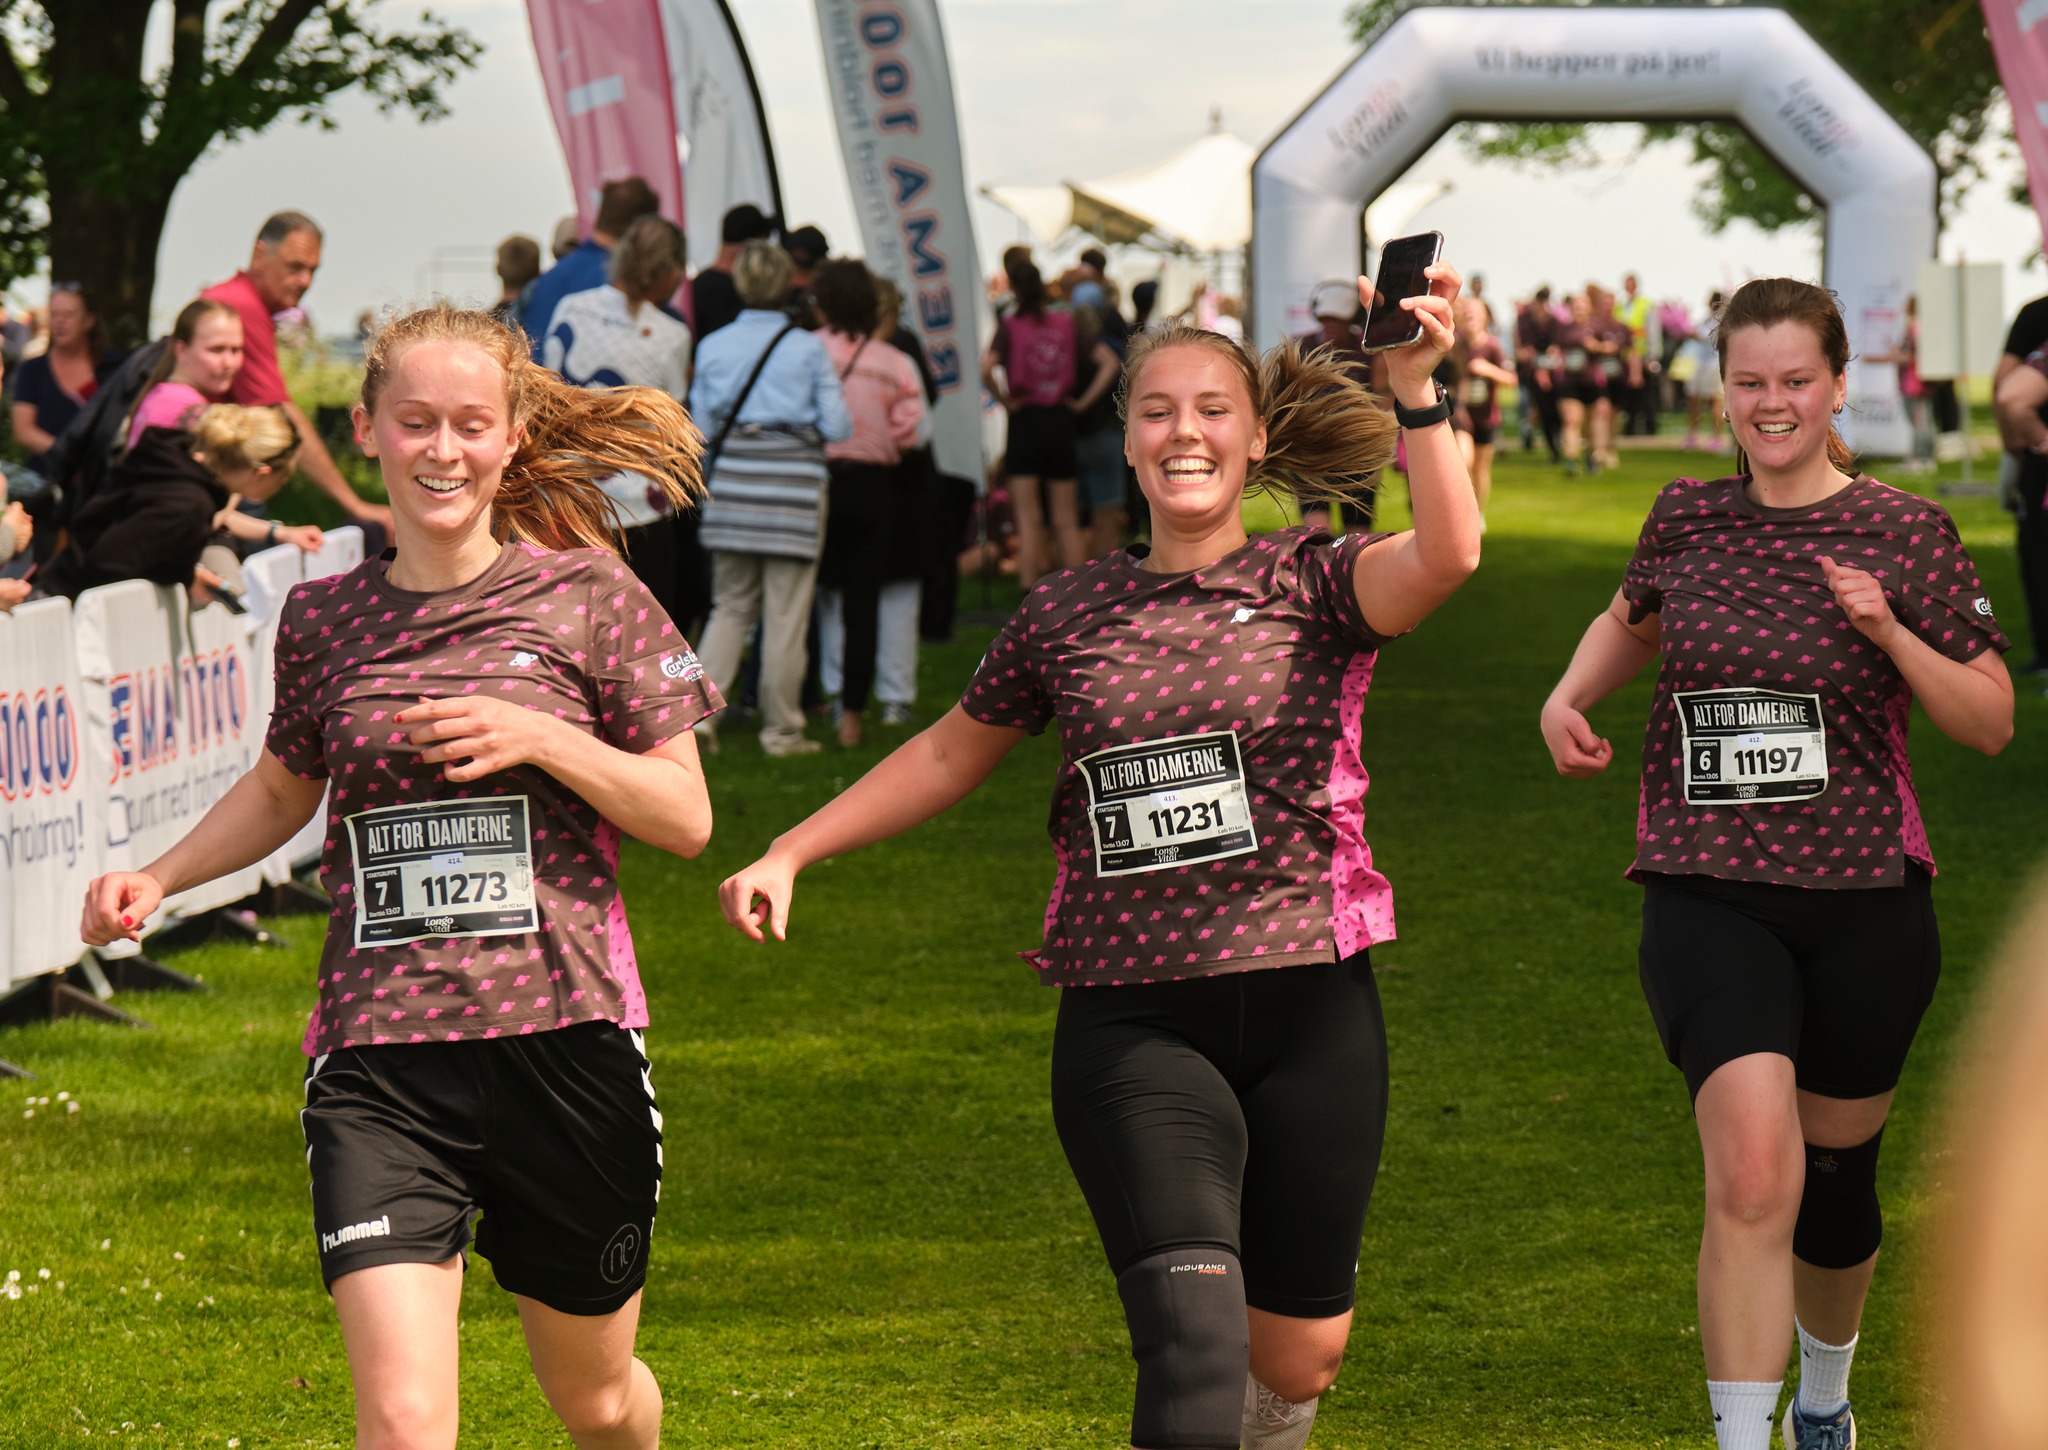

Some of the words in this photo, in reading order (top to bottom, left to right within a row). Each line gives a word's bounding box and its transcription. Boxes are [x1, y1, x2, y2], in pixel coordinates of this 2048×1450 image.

[1510, 47, 1618, 79] hepper
[1693, 704, 1712, 727] ALT
[1713, 704, 1736, 727] FOR
[1738, 702, 1809, 726] DAMERNE
[1100, 764, 1118, 792] ALT
[1117, 760, 1146, 788] FOR
[1146, 746, 1226, 784] DAMERNE
[1699, 750, 1712, 771] 6
[1734, 747, 1803, 776] 11197
[1736, 783, 1760, 793] Longo
[1739, 790, 1757, 799] Vital
[1105, 815, 1117, 839] 7
[1147, 798, 1224, 838] 11231
[368, 825, 390, 855] ALT
[393, 821, 425, 850] FOR
[427, 814, 513, 847] DAMERNE
[1115, 839, 1130, 848] 13:07
[1154, 845, 1180, 857] Longo
[1158, 850, 1178, 863] Vital
[375, 881, 388, 906] 7
[421, 871, 508, 907] 11273
[385, 906, 401, 916] 13:07
[425, 916, 455, 927] Longo
[430, 924, 451, 933] Vital
[322, 1214, 391, 1253] hummel
[1170, 1263, 1227, 1273] ENDURANCE
